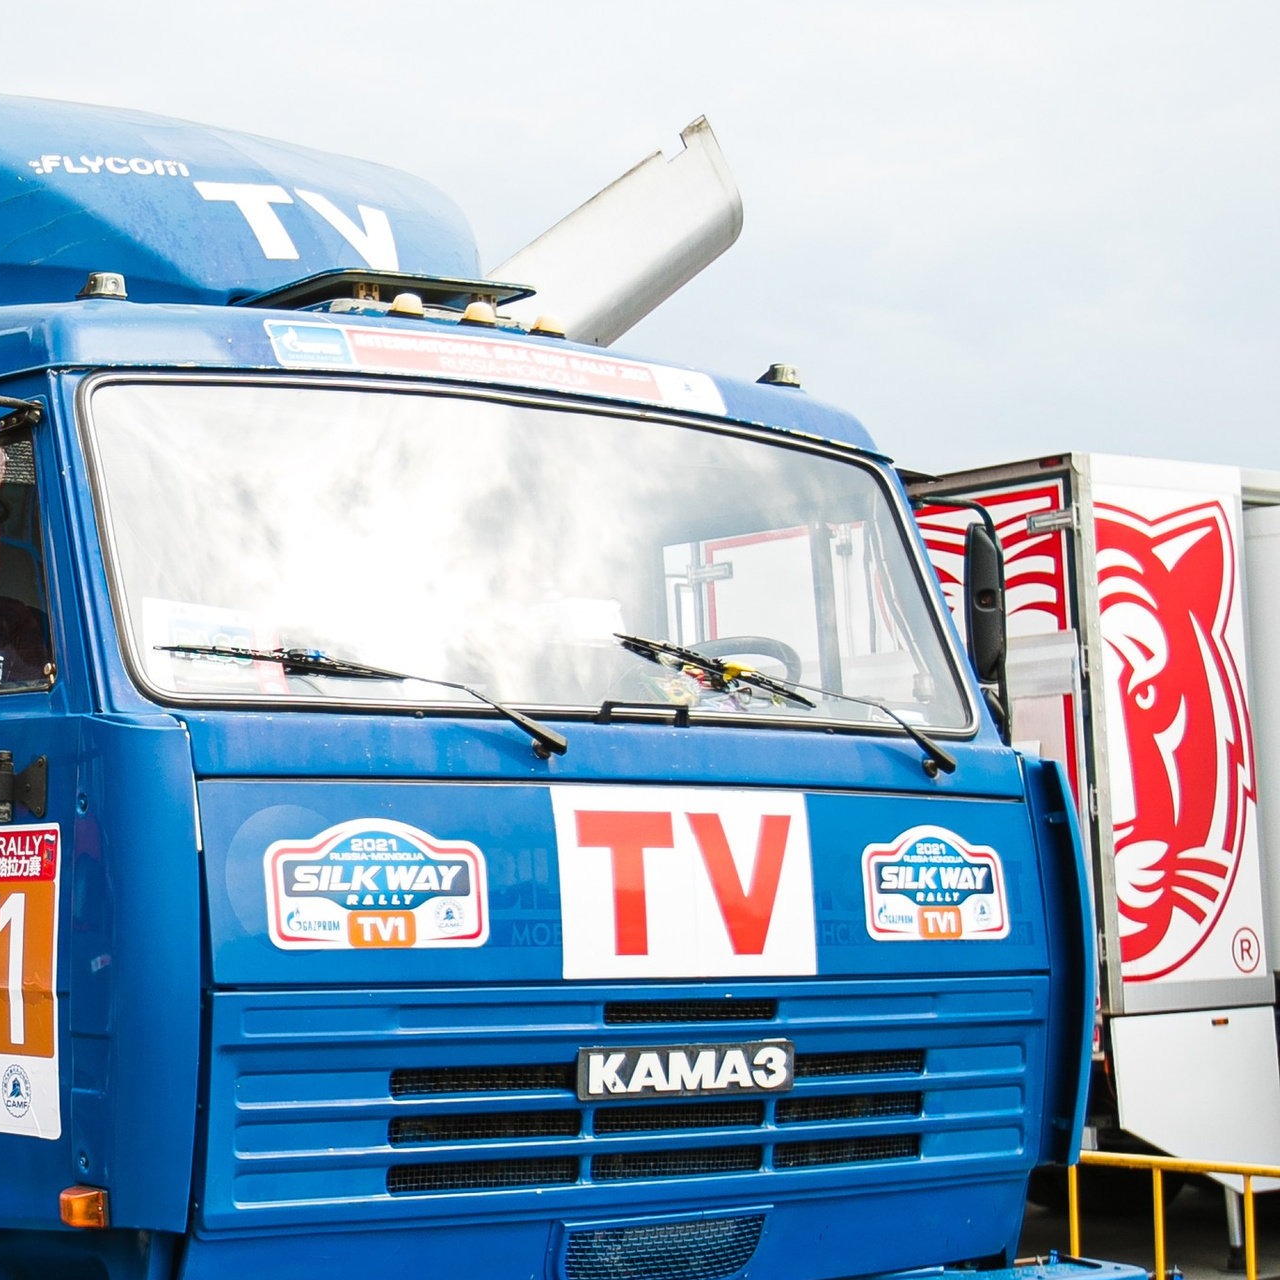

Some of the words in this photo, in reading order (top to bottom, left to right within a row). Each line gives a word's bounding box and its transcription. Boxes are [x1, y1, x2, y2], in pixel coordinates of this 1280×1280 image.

[193, 181, 400, 271] TV
[353, 333, 492, 359] INTERNATIONAL
[350, 838, 397, 852] 2021
[915, 843, 947, 856] 2021
[291, 865, 383, 892] SILK
[385, 865, 463, 892] WAY
[574, 809, 792, 956] TV
[880, 866, 938, 890] SILK
[939, 867, 988, 890] WAY
[346, 894, 414, 906] RALLY
[915, 892, 960, 903] RALLY
[302, 920, 340, 932] GAZPROM
[356, 916, 407, 942] TV1
[923, 911, 957, 934] TV1
